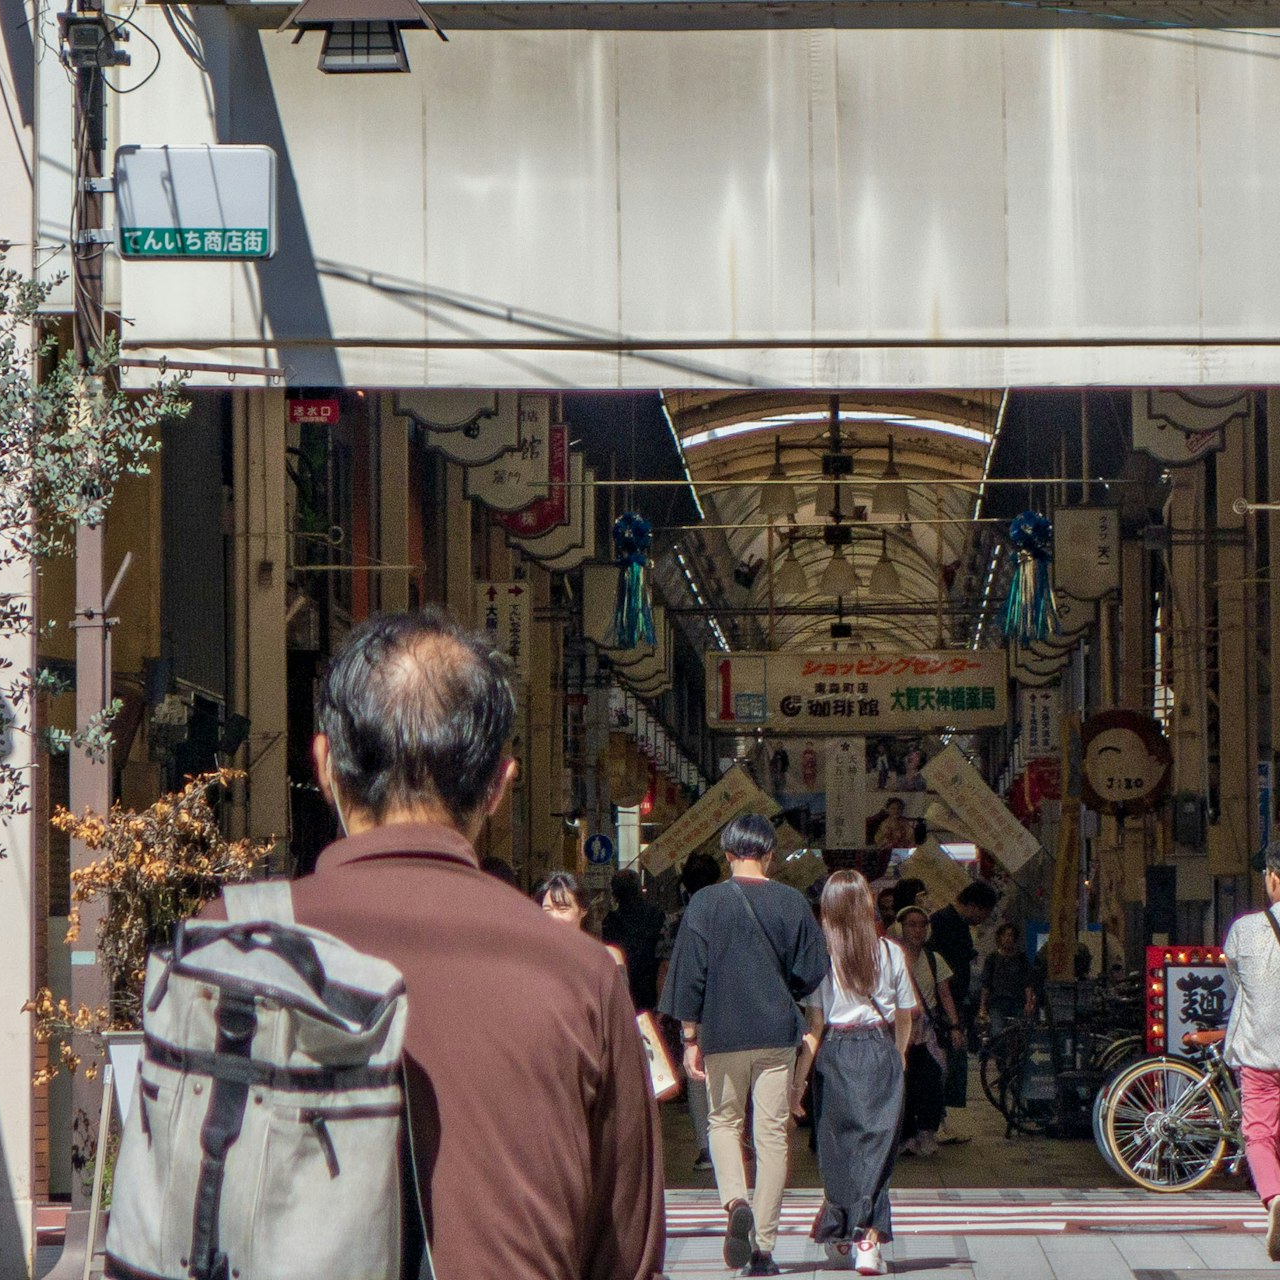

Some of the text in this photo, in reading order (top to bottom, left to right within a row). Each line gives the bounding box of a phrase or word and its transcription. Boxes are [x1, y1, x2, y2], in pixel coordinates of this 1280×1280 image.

[123, 229, 264, 254] てんいち商店街
[293, 405, 332, 418] 送水口
[801, 656, 983, 677] ショッピングセンター
[807, 697, 880, 718] 珈琲館
